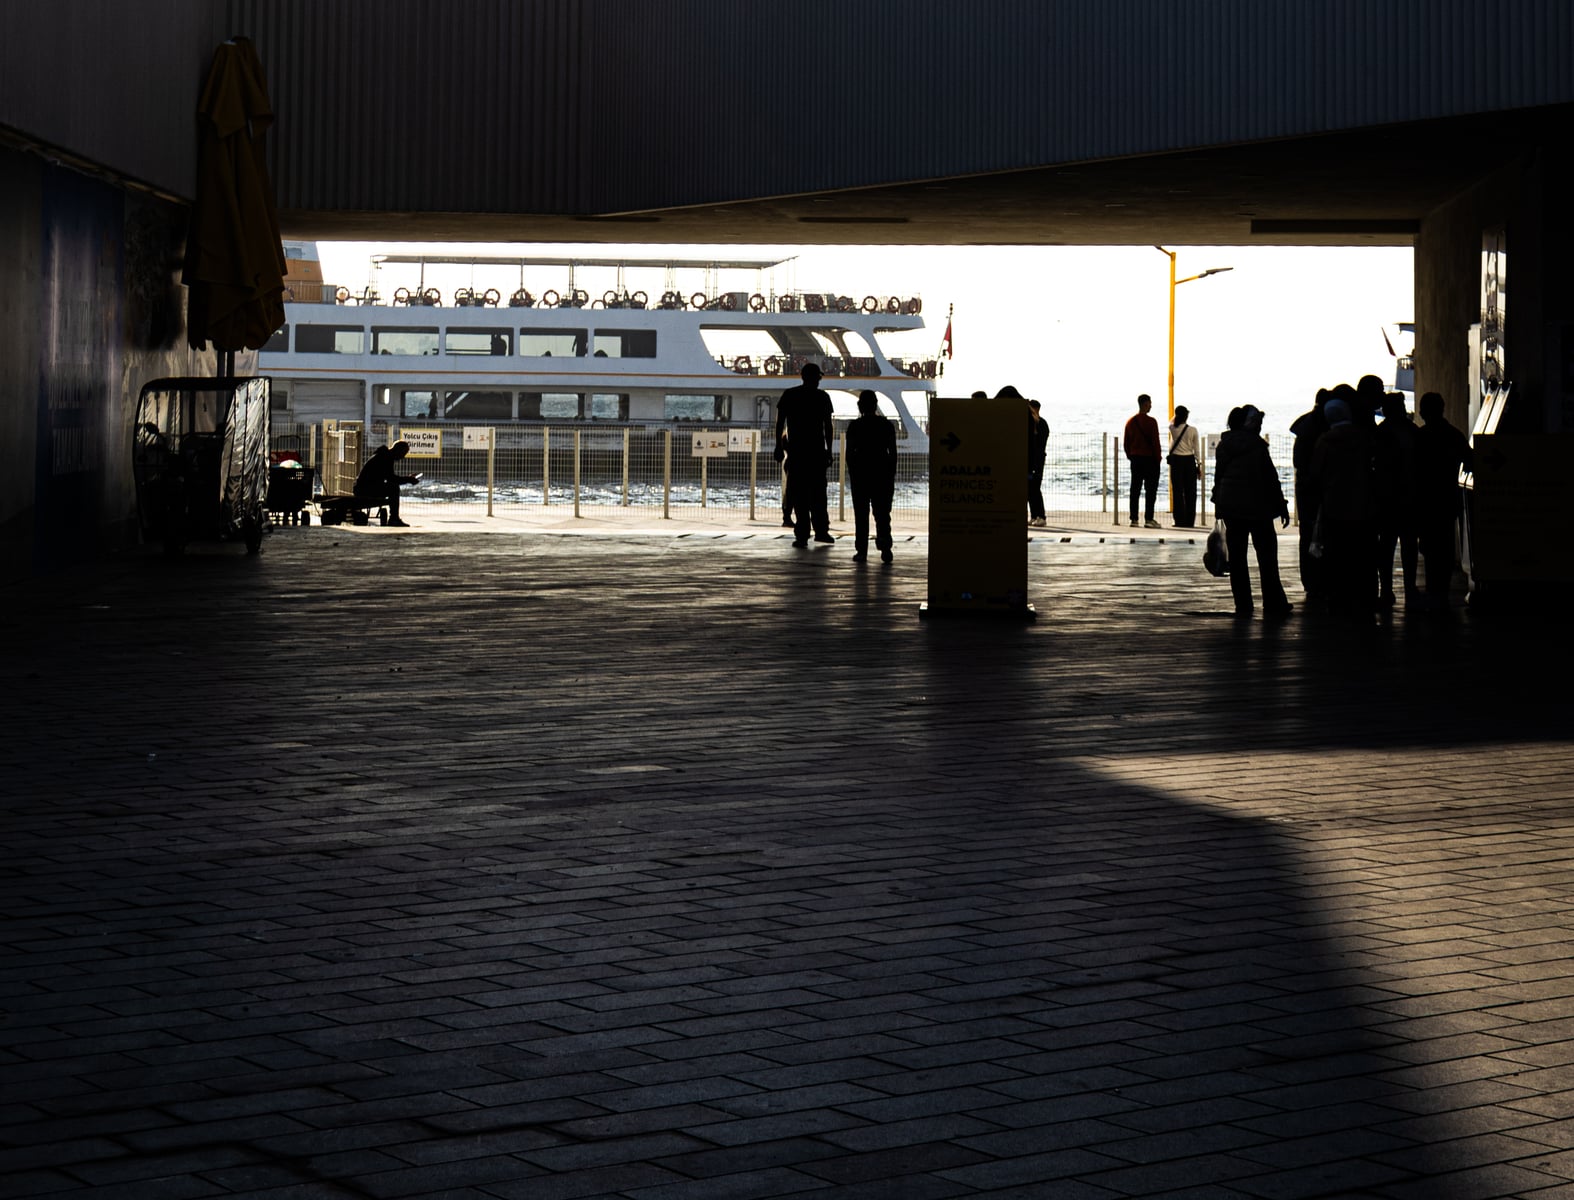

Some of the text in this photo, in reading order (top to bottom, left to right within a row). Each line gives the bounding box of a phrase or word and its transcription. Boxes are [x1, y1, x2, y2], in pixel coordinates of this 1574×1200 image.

[422, 432, 438, 441] Çıkış
[940, 465, 992, 476] ADALAR
[940, 493, 994, 505] ISLANDS
